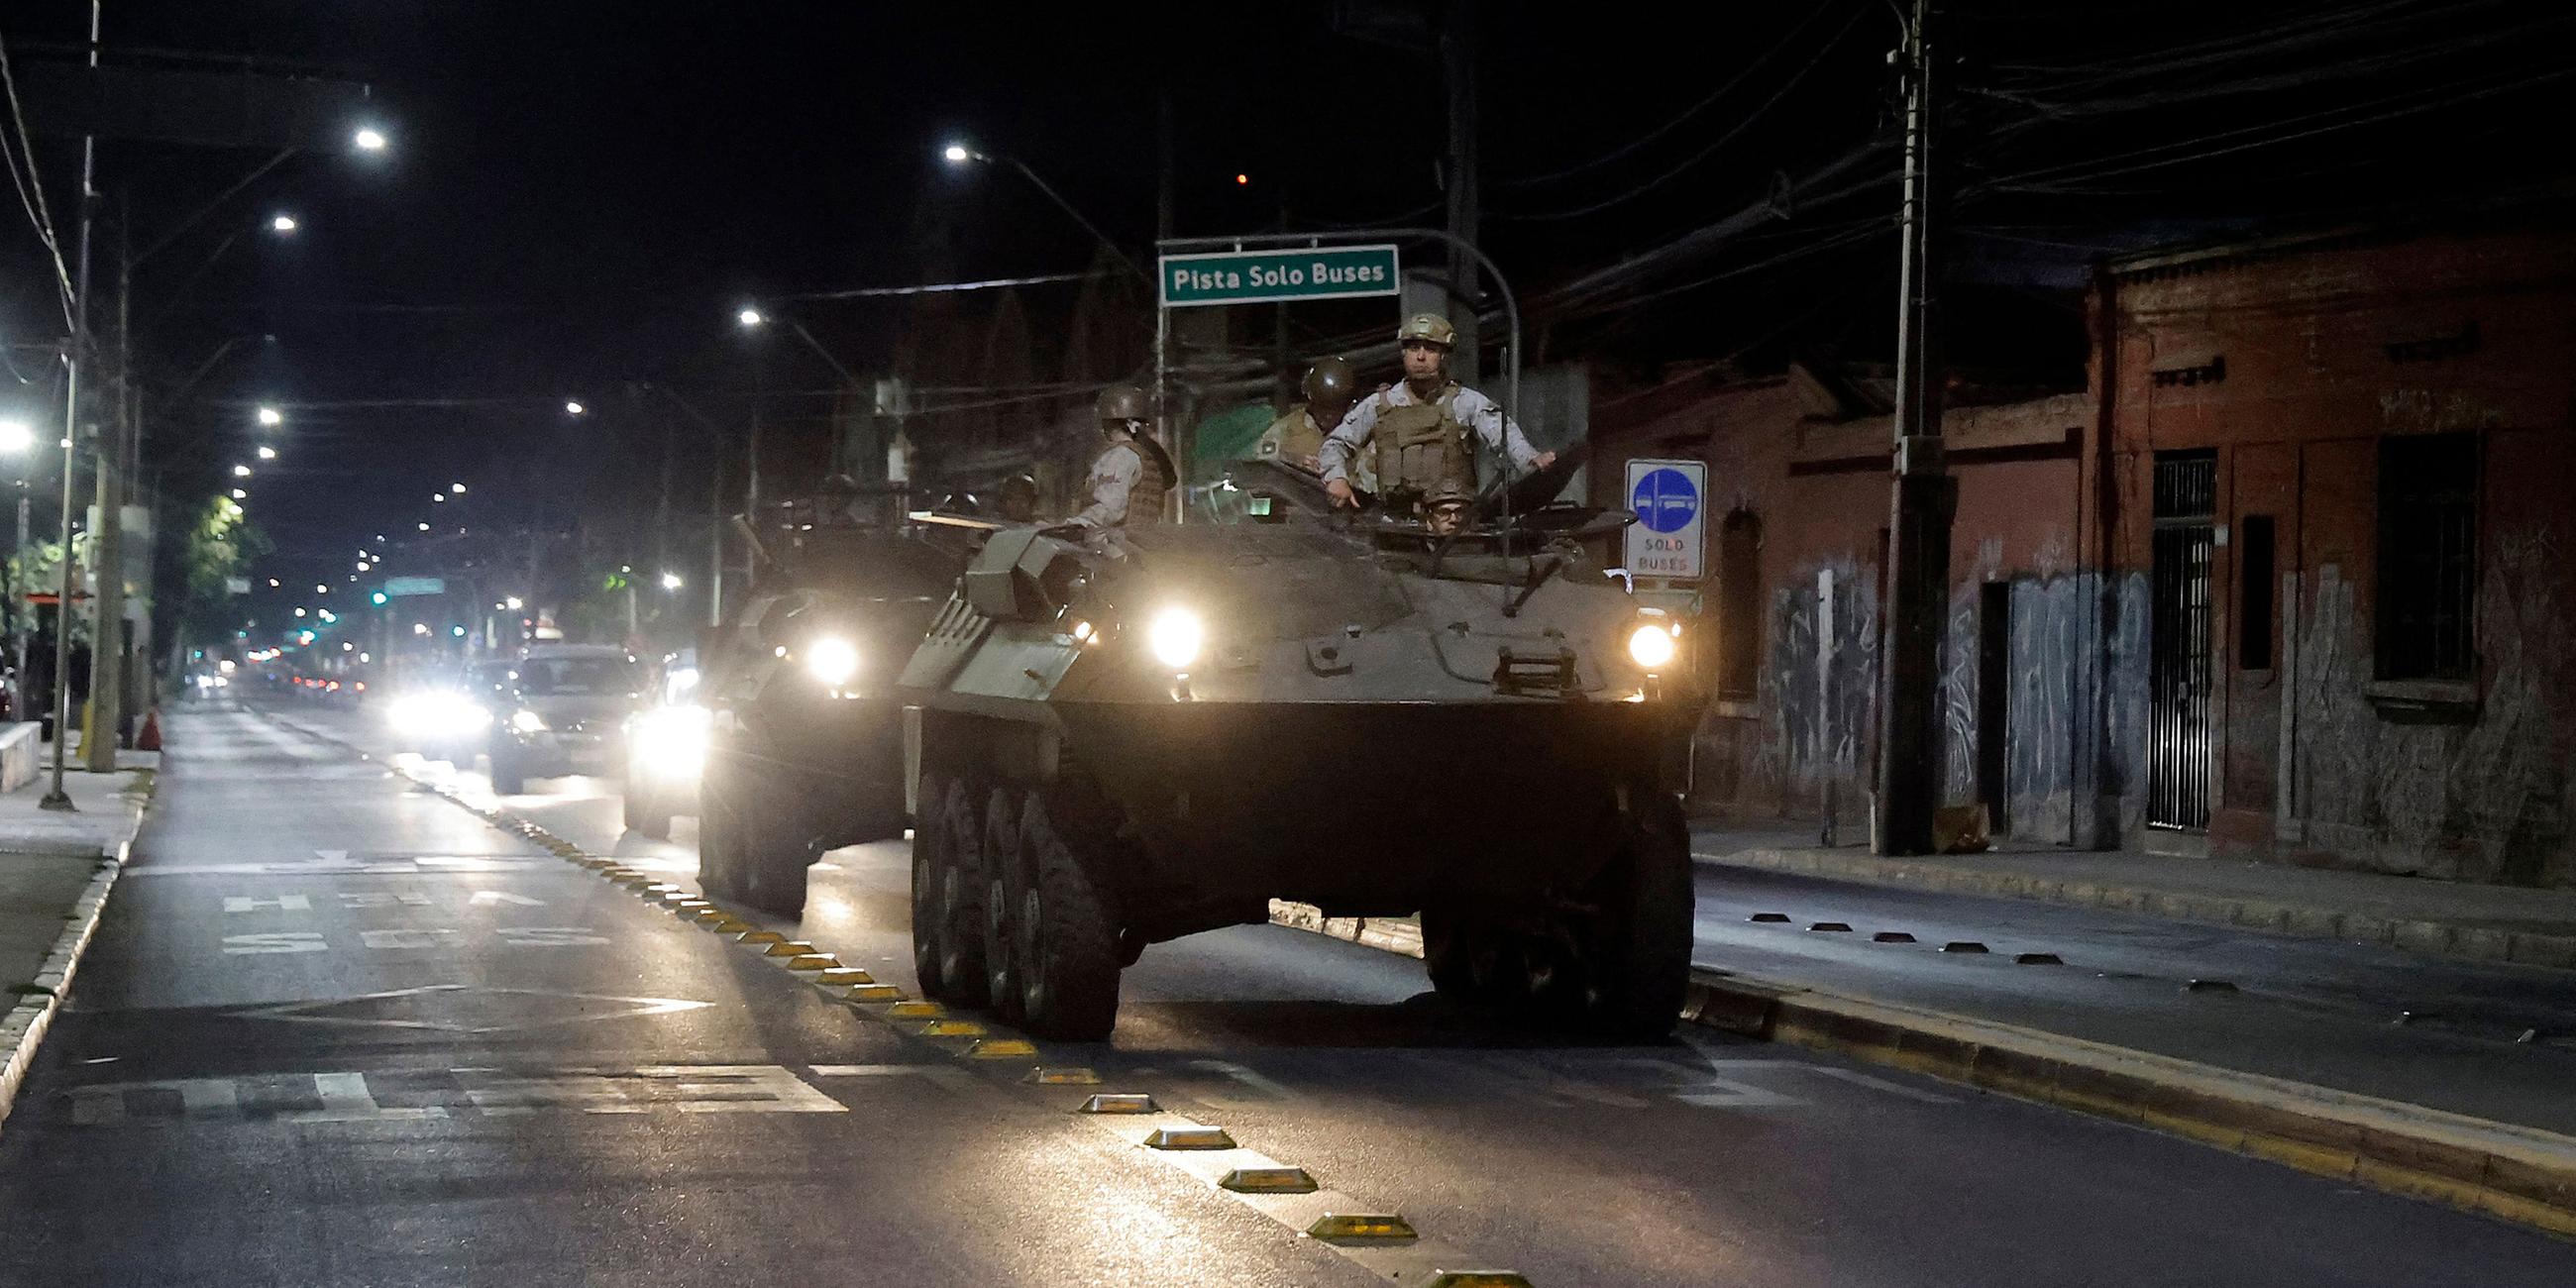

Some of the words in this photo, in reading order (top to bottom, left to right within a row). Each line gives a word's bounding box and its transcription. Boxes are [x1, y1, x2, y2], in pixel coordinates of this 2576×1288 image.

[1173, 268, 1240, 291] Pista
[1248, 265, 1305, 287] Solo
[1311, 262, 1385, 285] Buses
[1645, 538, 1683, 551] SOLO
[1639, 557, 1688, 570] BUSES
